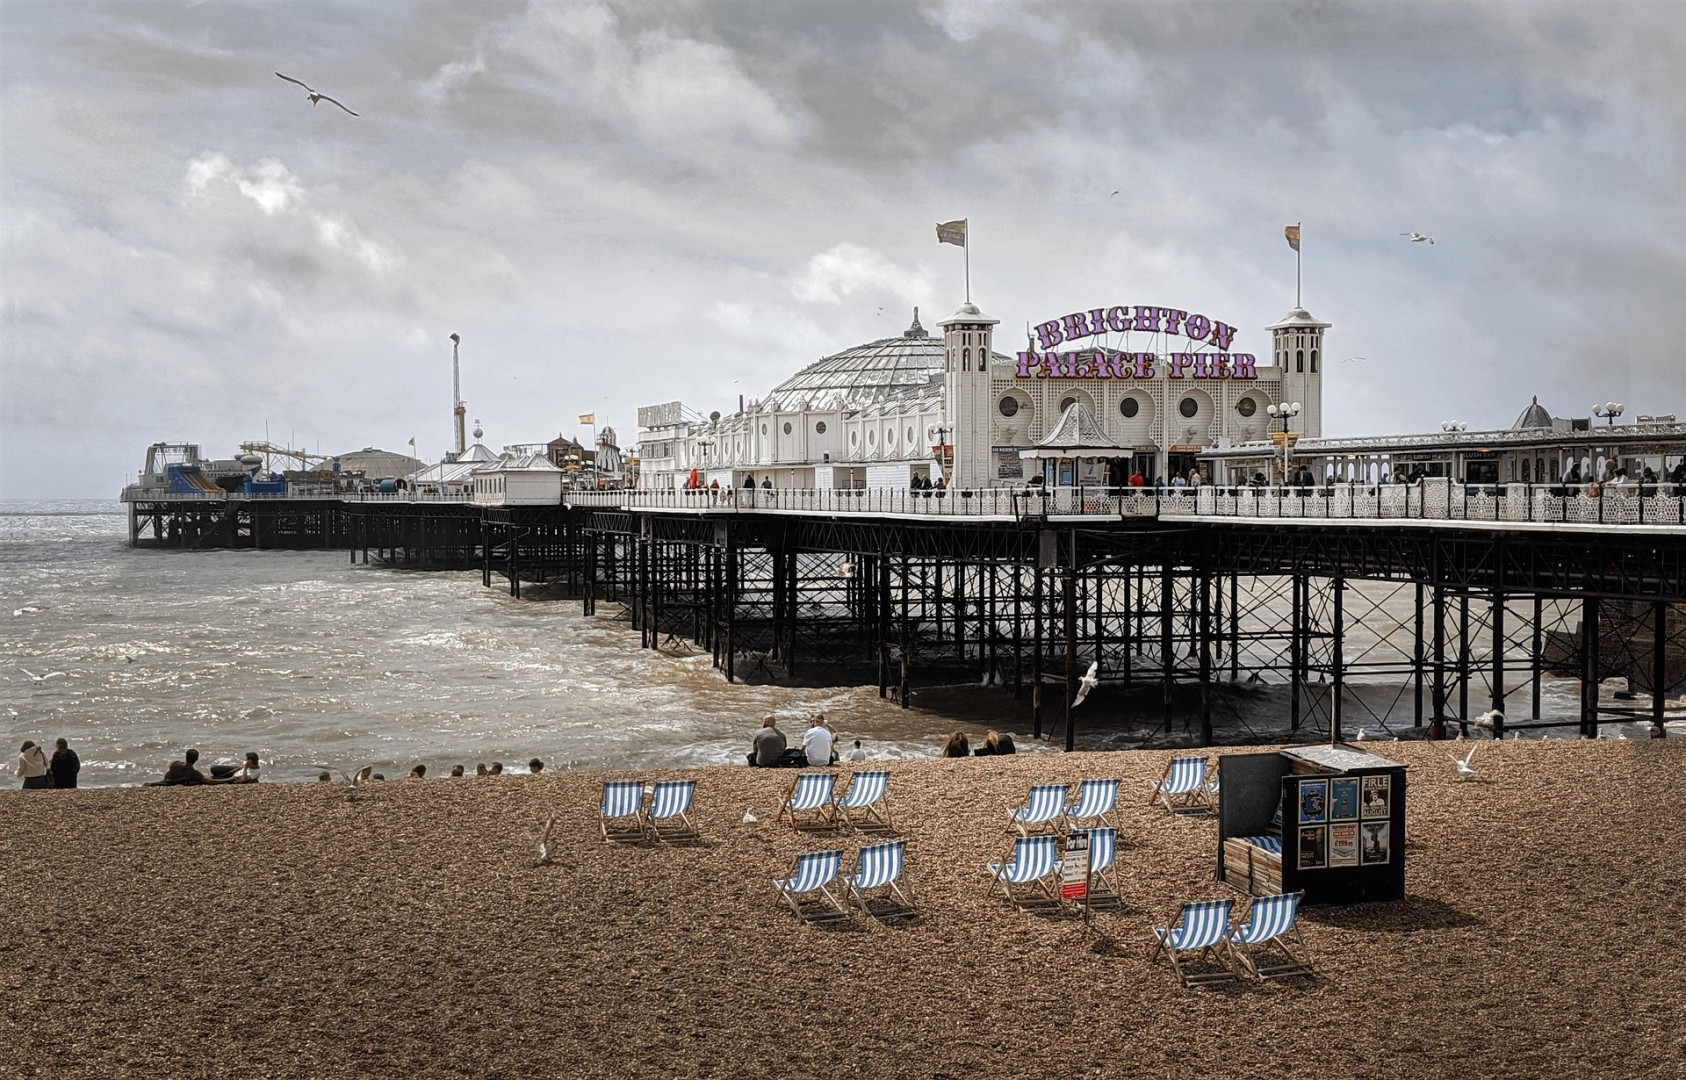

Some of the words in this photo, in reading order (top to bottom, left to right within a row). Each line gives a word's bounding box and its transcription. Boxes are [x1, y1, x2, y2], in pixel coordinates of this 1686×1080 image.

[1034, 306, 1238, 351] BRIGHTON
[1016, 352, 1156, 379] PALACE
[1169, 353, 1258, 379] PIER
[1363, 777, 1388, 787] FIRLE
[1066, 837, 1076, 850] For
[1076, 836, 1087, 850] Hire
